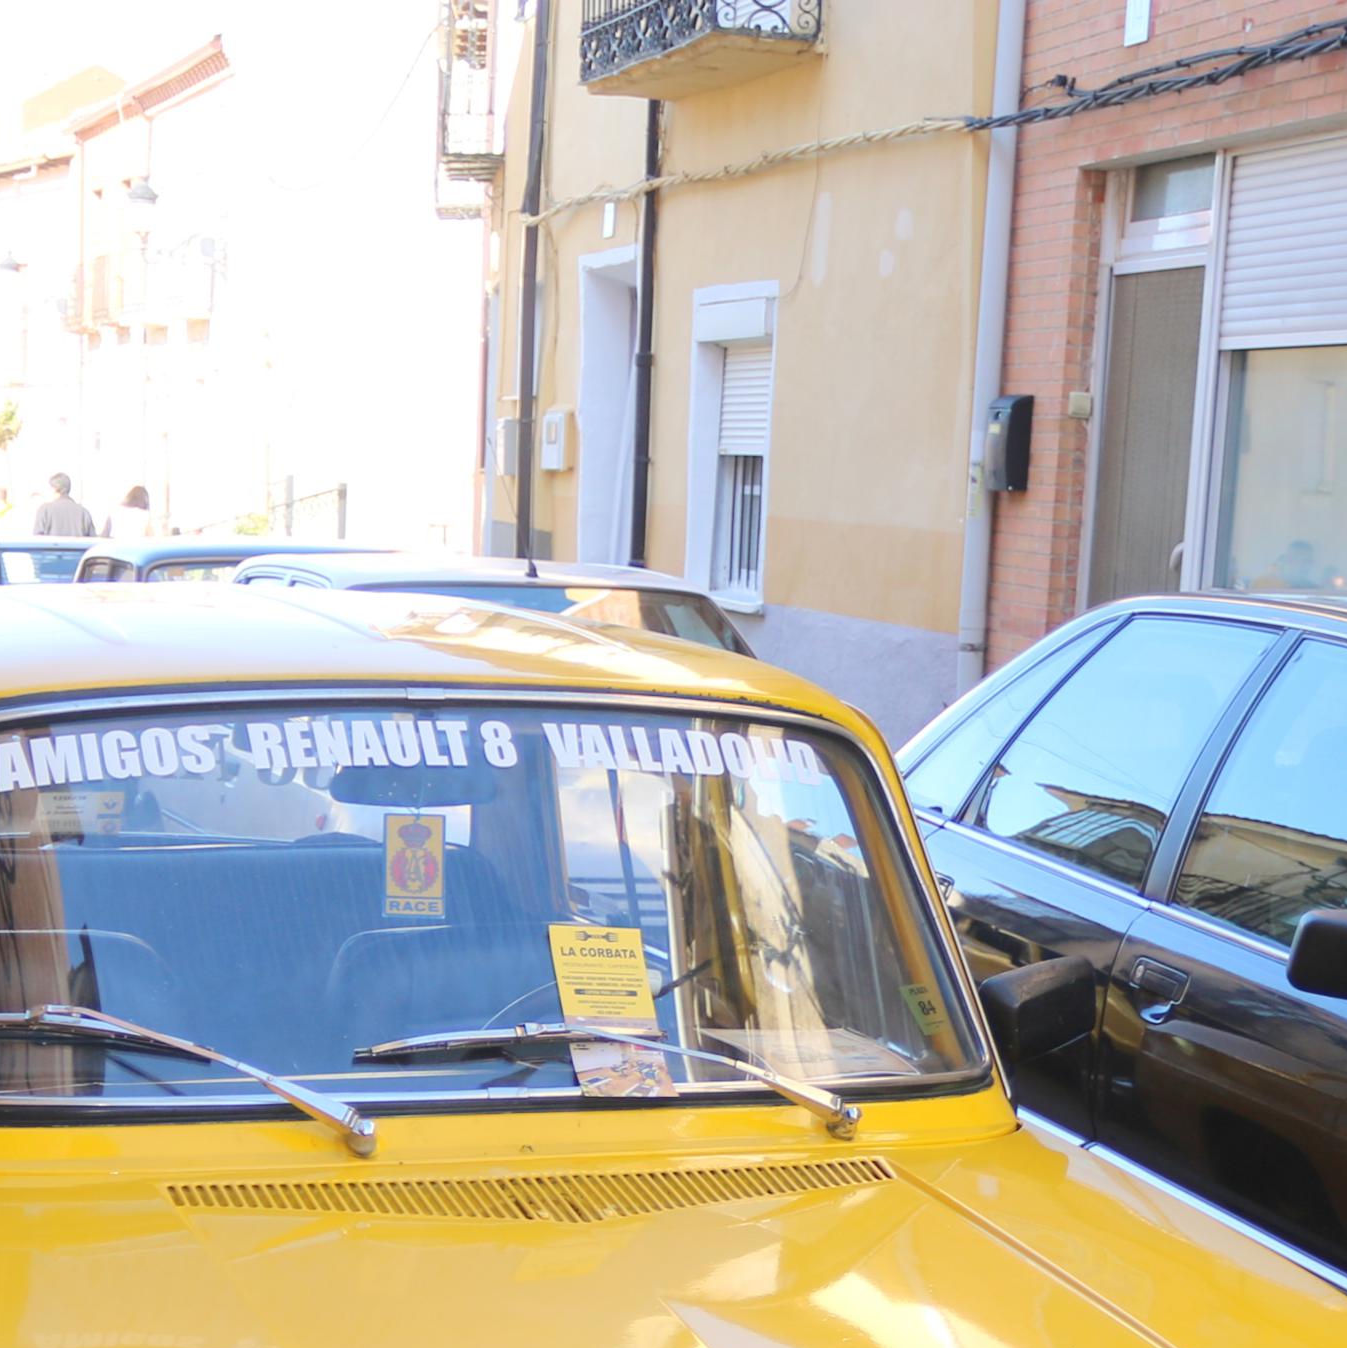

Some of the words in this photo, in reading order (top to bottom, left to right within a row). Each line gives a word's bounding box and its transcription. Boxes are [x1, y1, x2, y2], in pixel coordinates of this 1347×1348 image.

[246, 720, 468, 770] RENAULT
[479, 720, 518, 768] 8
[541, 721, 822, 786] VALLADOLID
[389, 900, 440, 912] RACE
[560, 946, 577, 957] LA
[579, 947, 638, 960] CORBATA
[917, 1000, 938, 1016] 84
